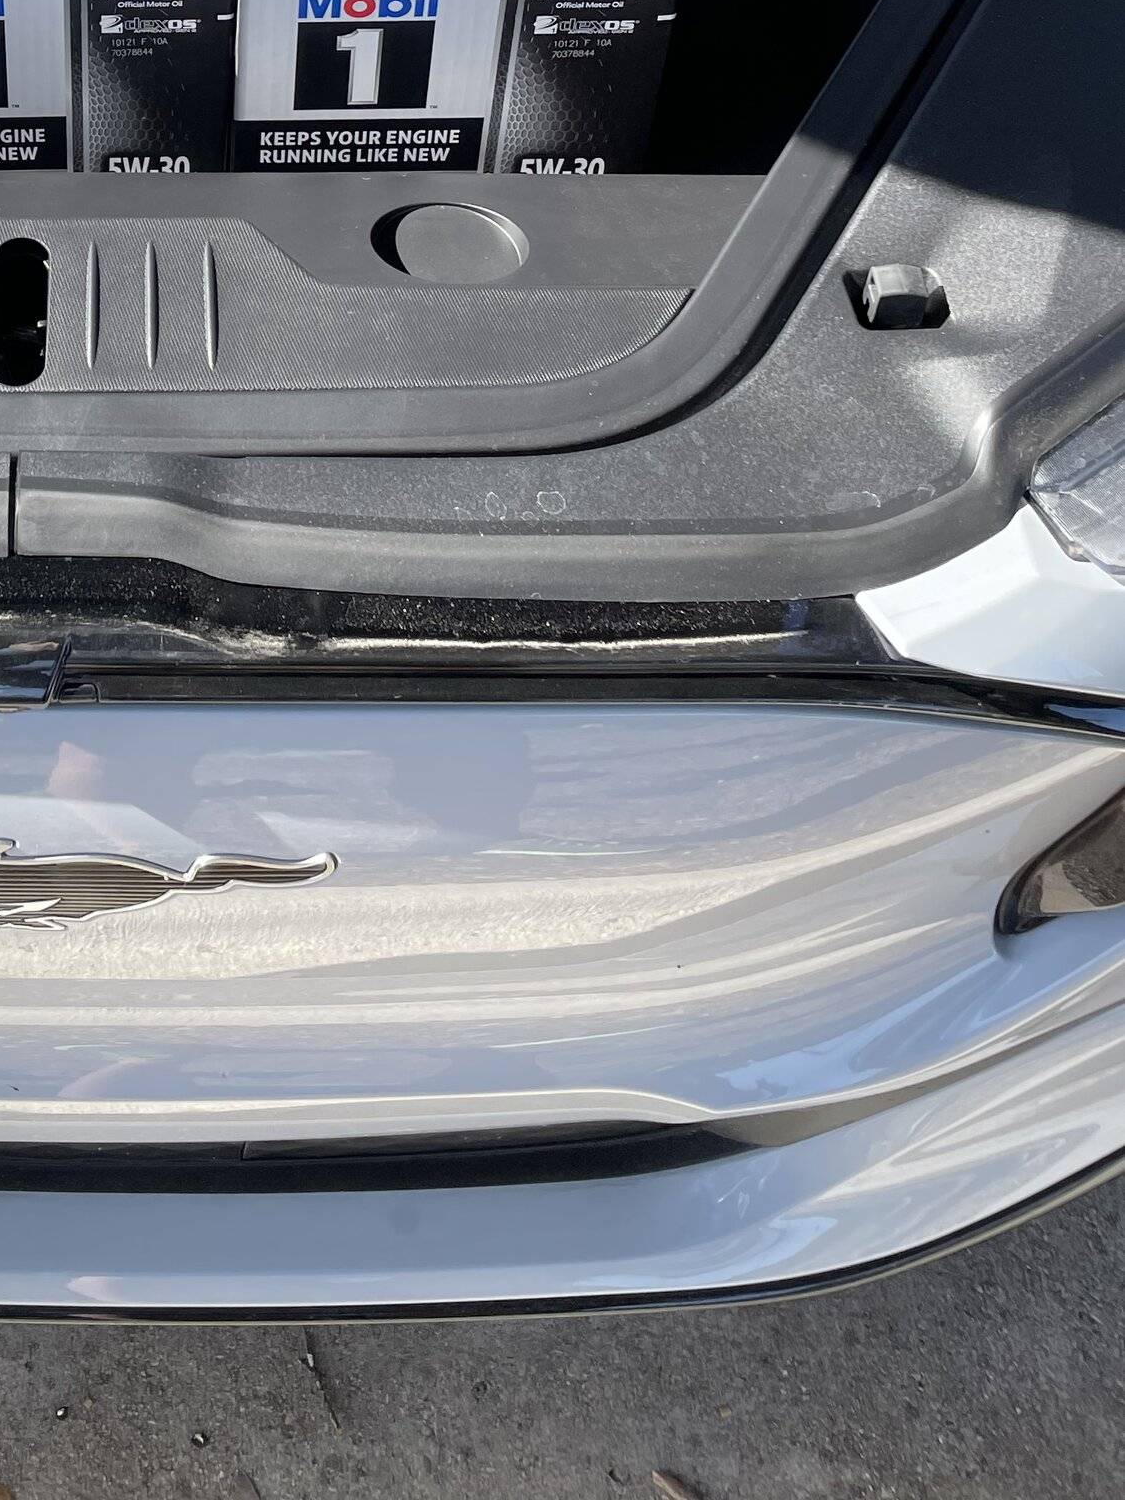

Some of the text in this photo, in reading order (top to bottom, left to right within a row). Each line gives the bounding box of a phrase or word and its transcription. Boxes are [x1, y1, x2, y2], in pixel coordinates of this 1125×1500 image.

[152, 37, 168, 45] 10A
[336, 28, 384, 105] 1
[260, 129, 460, 146] KEEPS YOUR ENGINE
[260, 147, 450, 164] RUNNING LIKE NEW
[109, 156, 190, 173] 5W-30
[520, 157, 605, 174] 5W-30
